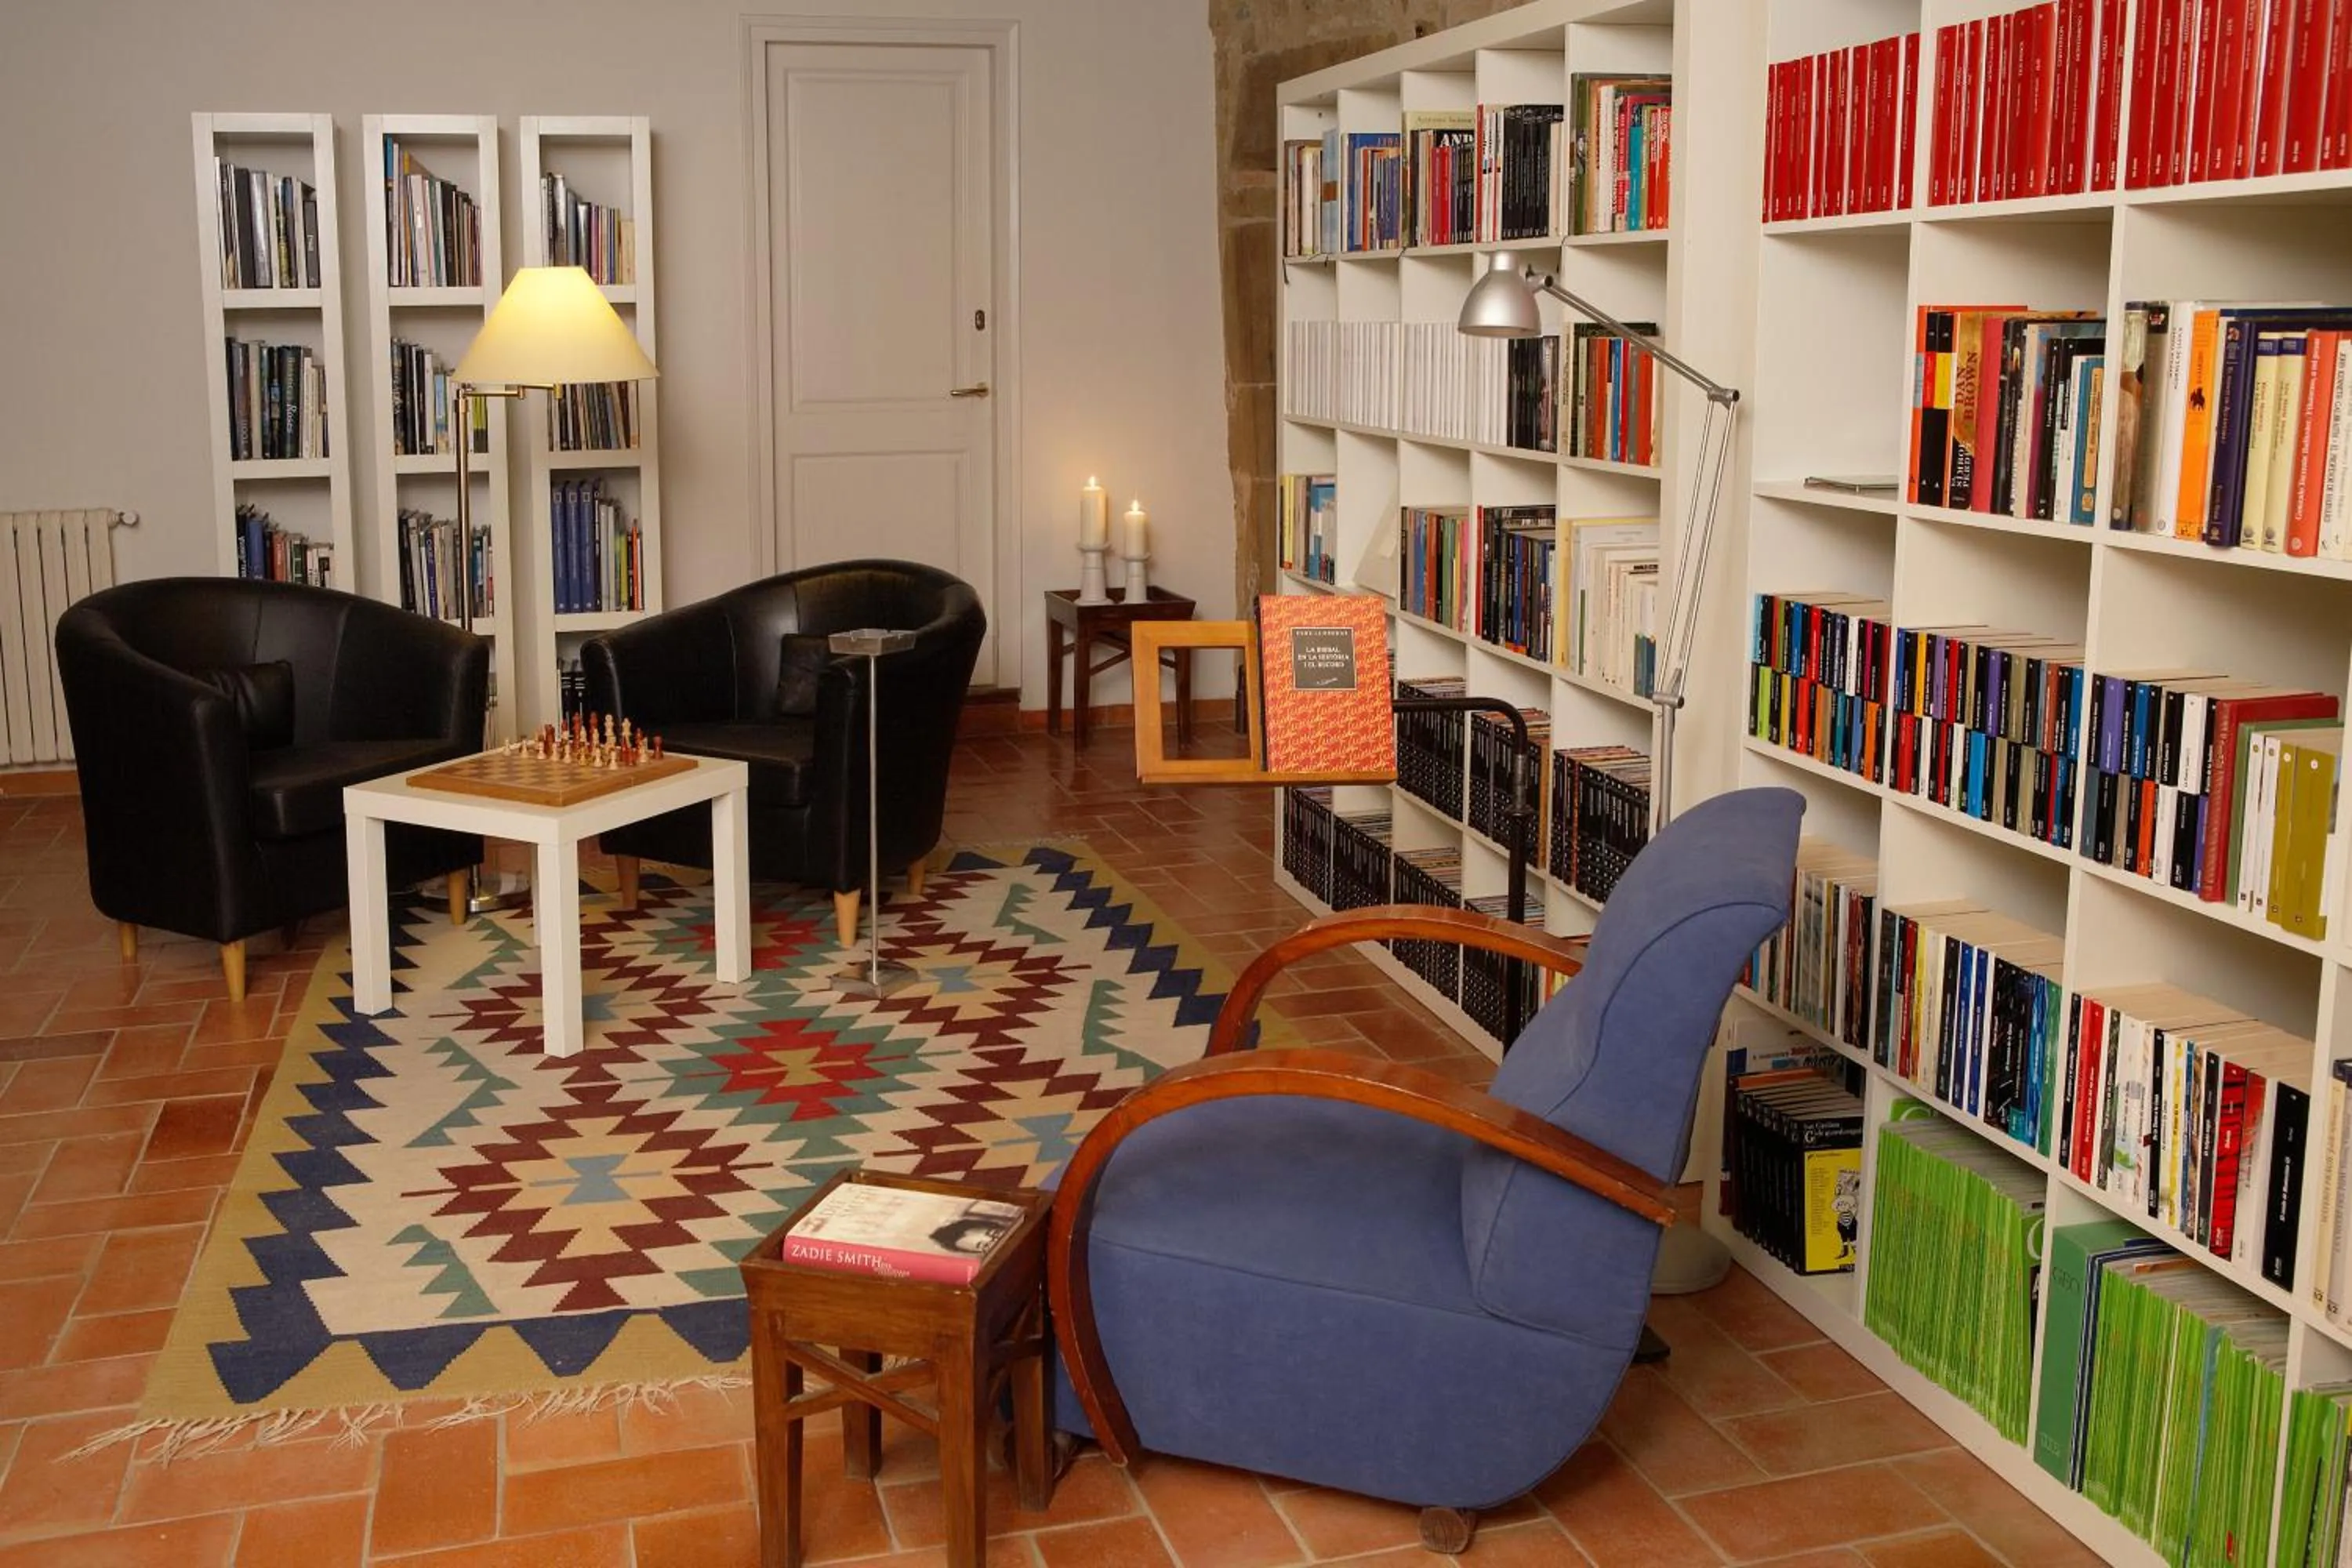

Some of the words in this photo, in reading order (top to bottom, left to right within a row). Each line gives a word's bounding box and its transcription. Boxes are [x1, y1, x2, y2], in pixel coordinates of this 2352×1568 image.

[1955, 367, 1966, 405] DAN
[1964, 351, 1978, 420] BROWN
[285, 403, 297, 434] Roses
[791, 1244, 833, 1262] ZADIE
[837, 1250, 882, 1269] SMITH
